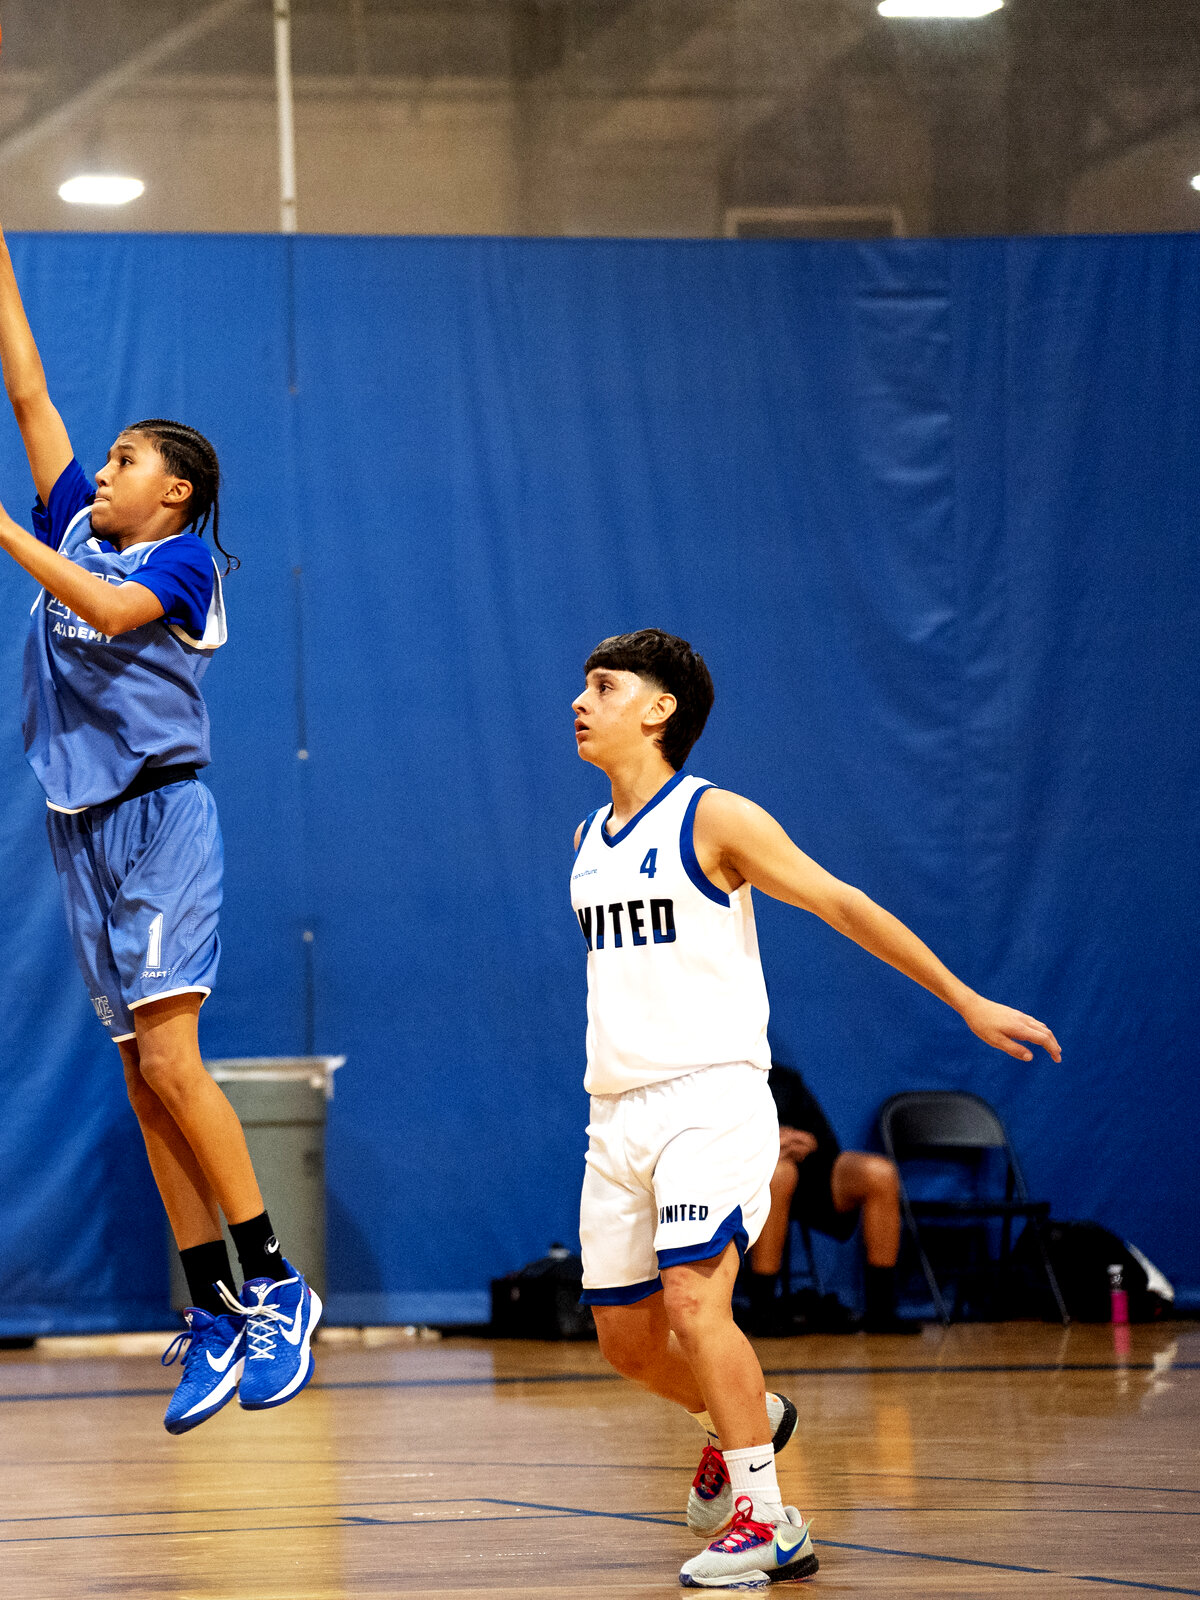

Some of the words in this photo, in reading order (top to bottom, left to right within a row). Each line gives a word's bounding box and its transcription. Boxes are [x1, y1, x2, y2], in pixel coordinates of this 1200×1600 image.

[53, 621, 114, 644] AADEMY
[639, 848, 658, 879] 4
[145, 912, 164, 969] 1
[577, 898, 677, 952] NITED
[140, 970, 168, 980] RAFT
